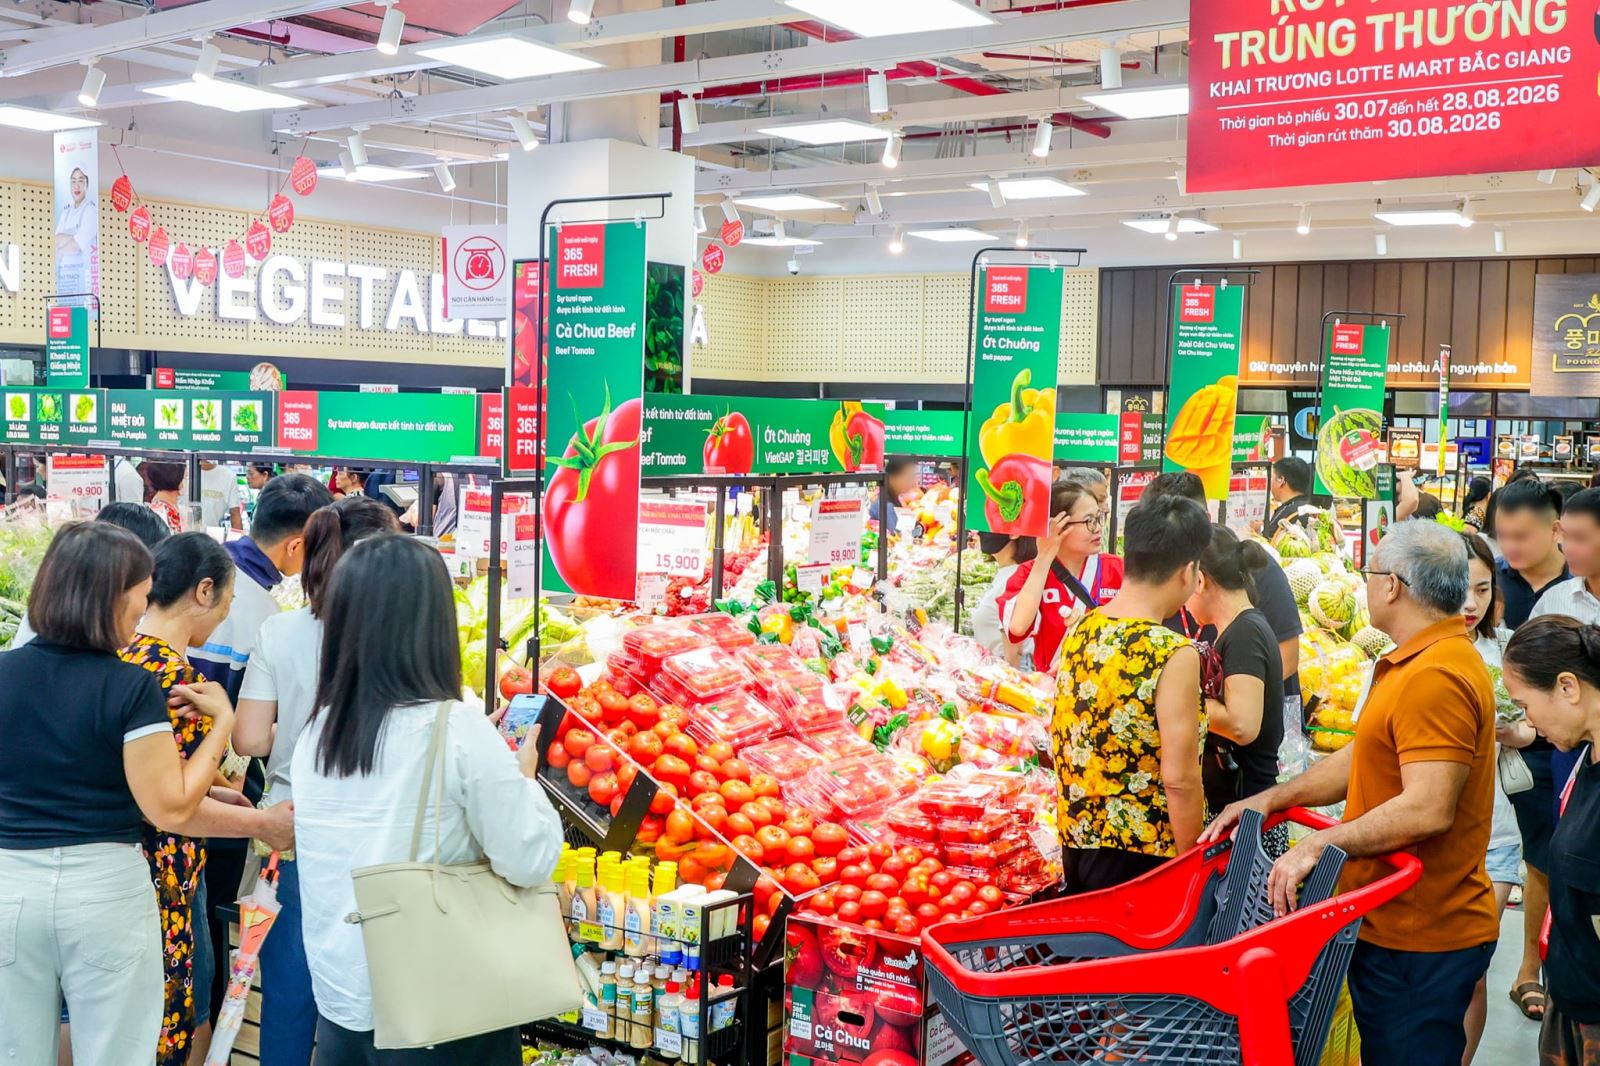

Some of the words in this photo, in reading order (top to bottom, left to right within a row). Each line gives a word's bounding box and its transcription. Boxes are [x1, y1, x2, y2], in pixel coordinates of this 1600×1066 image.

[1214, 15, 1357, 69] TRÚNG
[1366, 0, 1568, 53] THƯỜNG
[1209, 79, 1251, 98] KHAI
[1254, 70, 1332, 93] TRƯƠNG
[1336, 64, 1394, 85] LOTTE
[1398, 58, 1455, 79] MART
[1459, 50, 1500, 73] BẮC
[1505, 46, 1571, 68] GIANG
[1219, 116, 1246, 131] Thời
[1248, 115, 1275, 130] gian
[1278, 113, 1293, 126] bỏ
[1295, 107, 1330, 126] phiếu
[1334, 99, 1389, 121] 30.07
[1389, 99, 1413, 115] đến
[1417, 97, 1439, 113] hết
[1442, 83, 1560, 111] 28.08.2026
[1268, 134, 1295, 147] Thời
[1298, 132, 1325, 147] gian
[1328, 128, 1346, 142] rút
[1350, 128, 1383, 141] thăm
[1387, 111, 1501, 138] 30.08.2026
[275, 217, 289, 231] 50
[563, 247, 583, 261] 365
[563, 263, 598, 277] FRESH
[991, 283, 1008, 293] 365
[990, 295, 1021, 305] FRESH
[1185, 298, 1199, 307] 365
[1184, 308, 1209, 316] FRESH
[555, 322, 572, 339] Cà
[574, 322, 605, 339] Chua
[607, 322, 637, 339] Beef
[982, 334, 996, 349] Ớt
[998, 337, 1040, 352] Chuông
[555, 346, 570, 355] Beef
[571, 346, 596, 355] Tomato
[1249, 361, 1269, 372] Giữ
[1269, 361, 1308, 374] nguyên
[1387, 361, 1401, 373] mì
[1402, 361, 1430, 373] châu
[1450, 362, 1492, 376] nguyên
[1494, 361, 1517, 373] bản
[111, 403, 126, 413] RAU
[645, 406, 658, 420] kết
[659, 407, 674, 420] tinh
[675, 408, 684, 420] từ
[684, 407, 696, 420] đất
[697, 409, 713, 420] lành
[283, 412, 300, 425] 365
[327, 418, 338, 430] Sự
[338, 419, 352, 429] tươi
[352, 421, 369, 431] ngon
[370, 420, 388, 431] được
[388, 419, 400, 430] kết
[400, 421, 415, 431] tinh
[424, 420, 437, 432] đất
[438, 422, 454, 432] lành
[283, 428, 313, 440] FRESH
[764, 424, 776, 444] Ớt
[777, 428, 811, 447] Chuông
[655, 452, 686, 466] Tomato
[764, 451, 795, 464] VietGAP
[656, 553, 699, 570] 15,900
[831, 549, 856, 562] 59,900
[792, 1012, 811, 1022] FRESH
[814, 1024, 833, 1040] Cà
[835, 1029, 870, 1050] Chua
